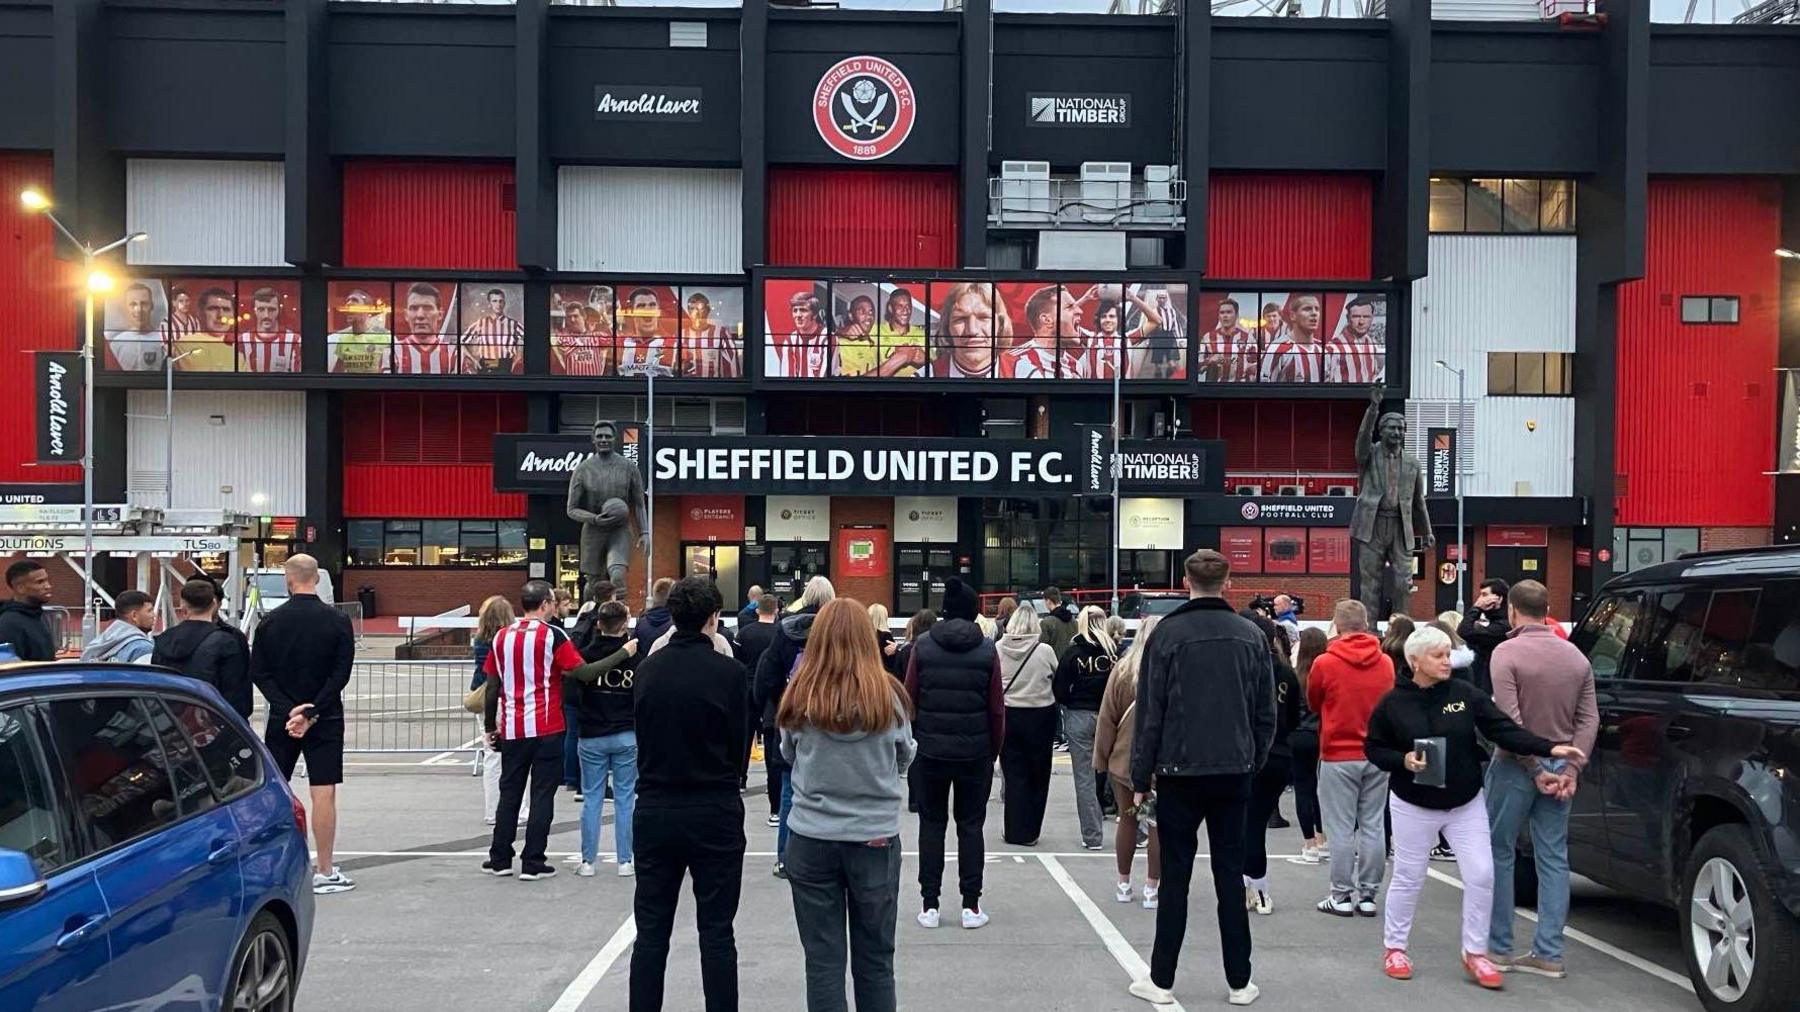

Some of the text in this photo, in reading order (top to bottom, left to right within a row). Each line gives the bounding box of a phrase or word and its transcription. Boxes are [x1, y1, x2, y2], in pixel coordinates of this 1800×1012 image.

[818, 61, 911, 109] SHEFFIELD UNITED F.C.
[597, 93, 700, 114] Arnold Laver
[1056, 98, 1118, 109] NATIONAL
[1056, 109, 1119, 123] TIMBER
[853, 145, 877, 156] 1889
[49, 361, 68, 456] Arnold Laver
[520, 451, 584, 472] Arnold
[655, 447, 1073, 482] SHEFFIELD UNITED F.C.
[1090, 430, 1103, 490] Arnold Laver
[1124, 453, 1191, 465] NATIONAL
[1191, 453, 1199, 479] GROUP
[1434, 450, 1443, 488] TIMBER
[1124, 465, 1191, 479] TIMBER
[5, 495, 44, 503] UNITED
[1443, 701, 1465, 714] MC8
